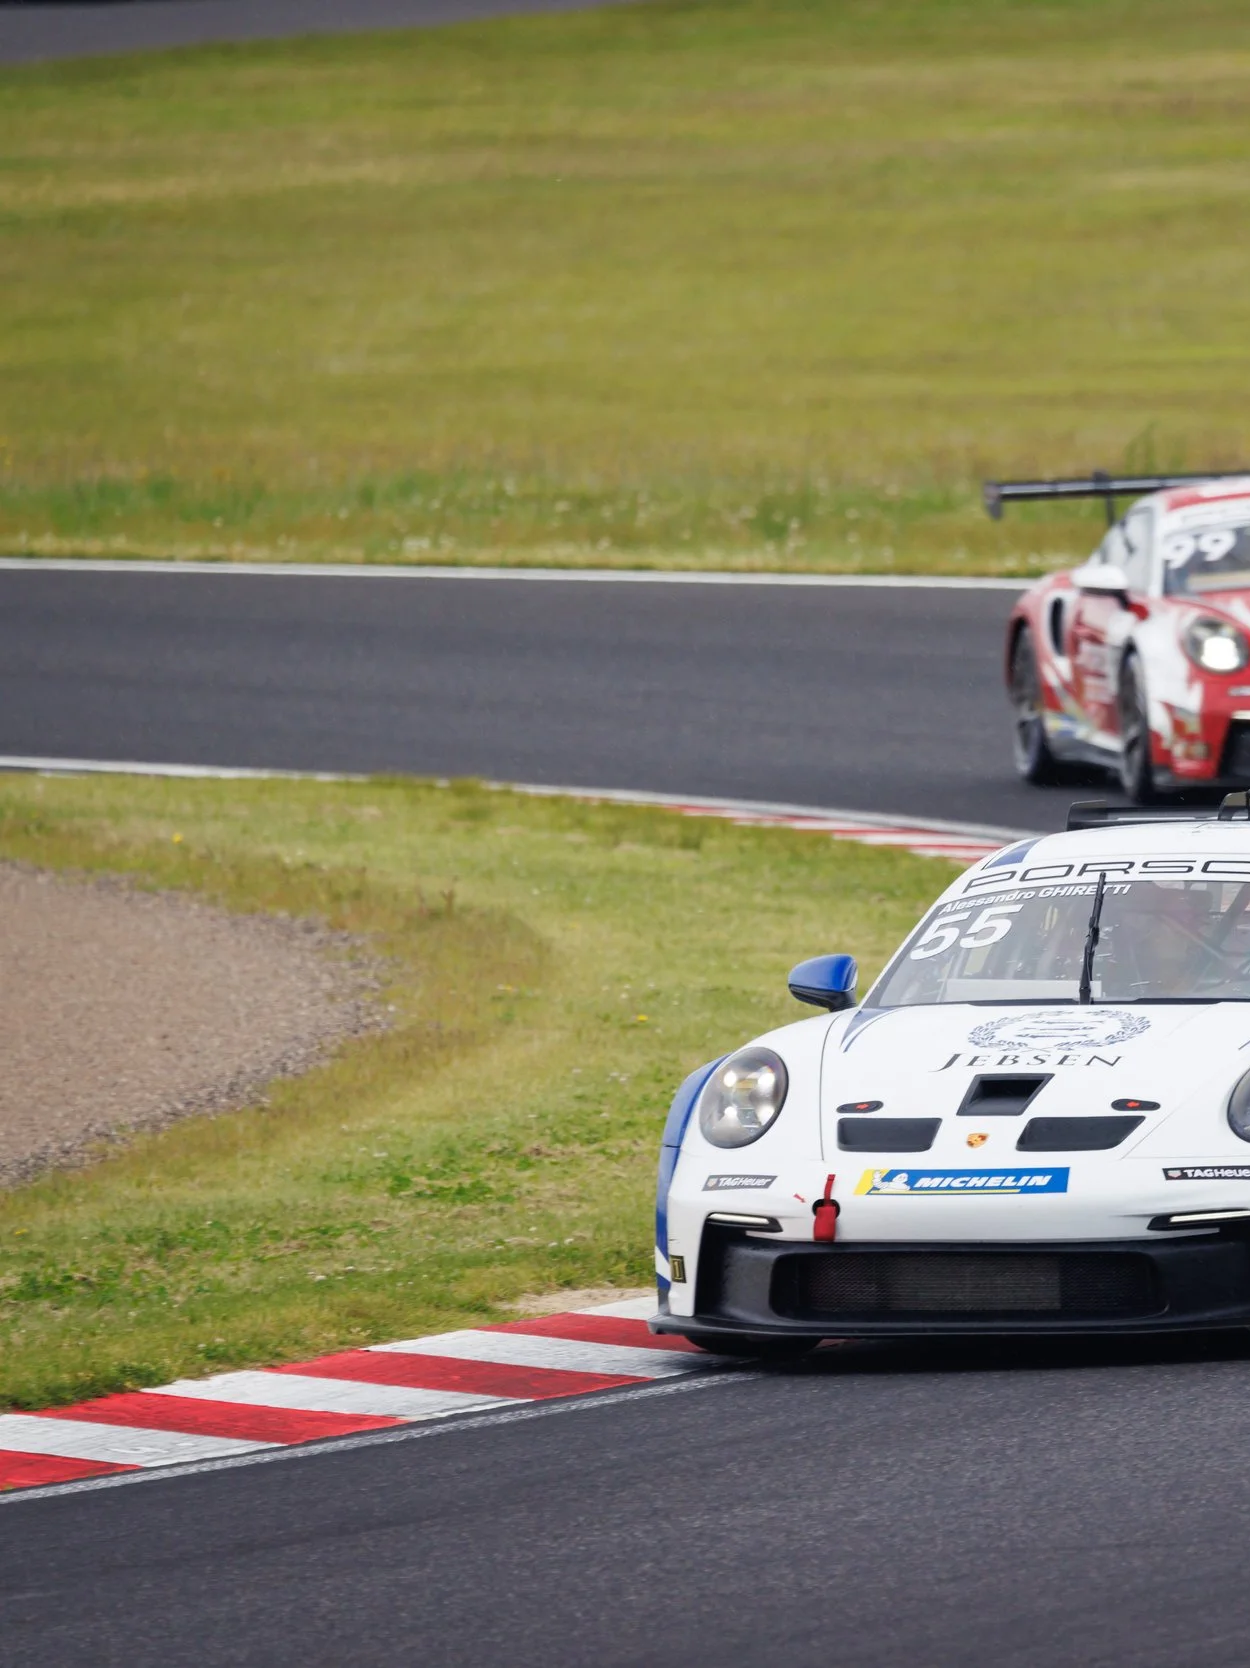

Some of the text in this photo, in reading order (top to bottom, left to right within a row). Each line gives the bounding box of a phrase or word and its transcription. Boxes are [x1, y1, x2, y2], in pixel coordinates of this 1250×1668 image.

[937, 889, 1034, 916] Alessandro
[909, 904, 1024, 961] 55
[932, 1053, 1123, 1072] JEBSEN
[913, 1175, 1052, 1188] MICHELIN
